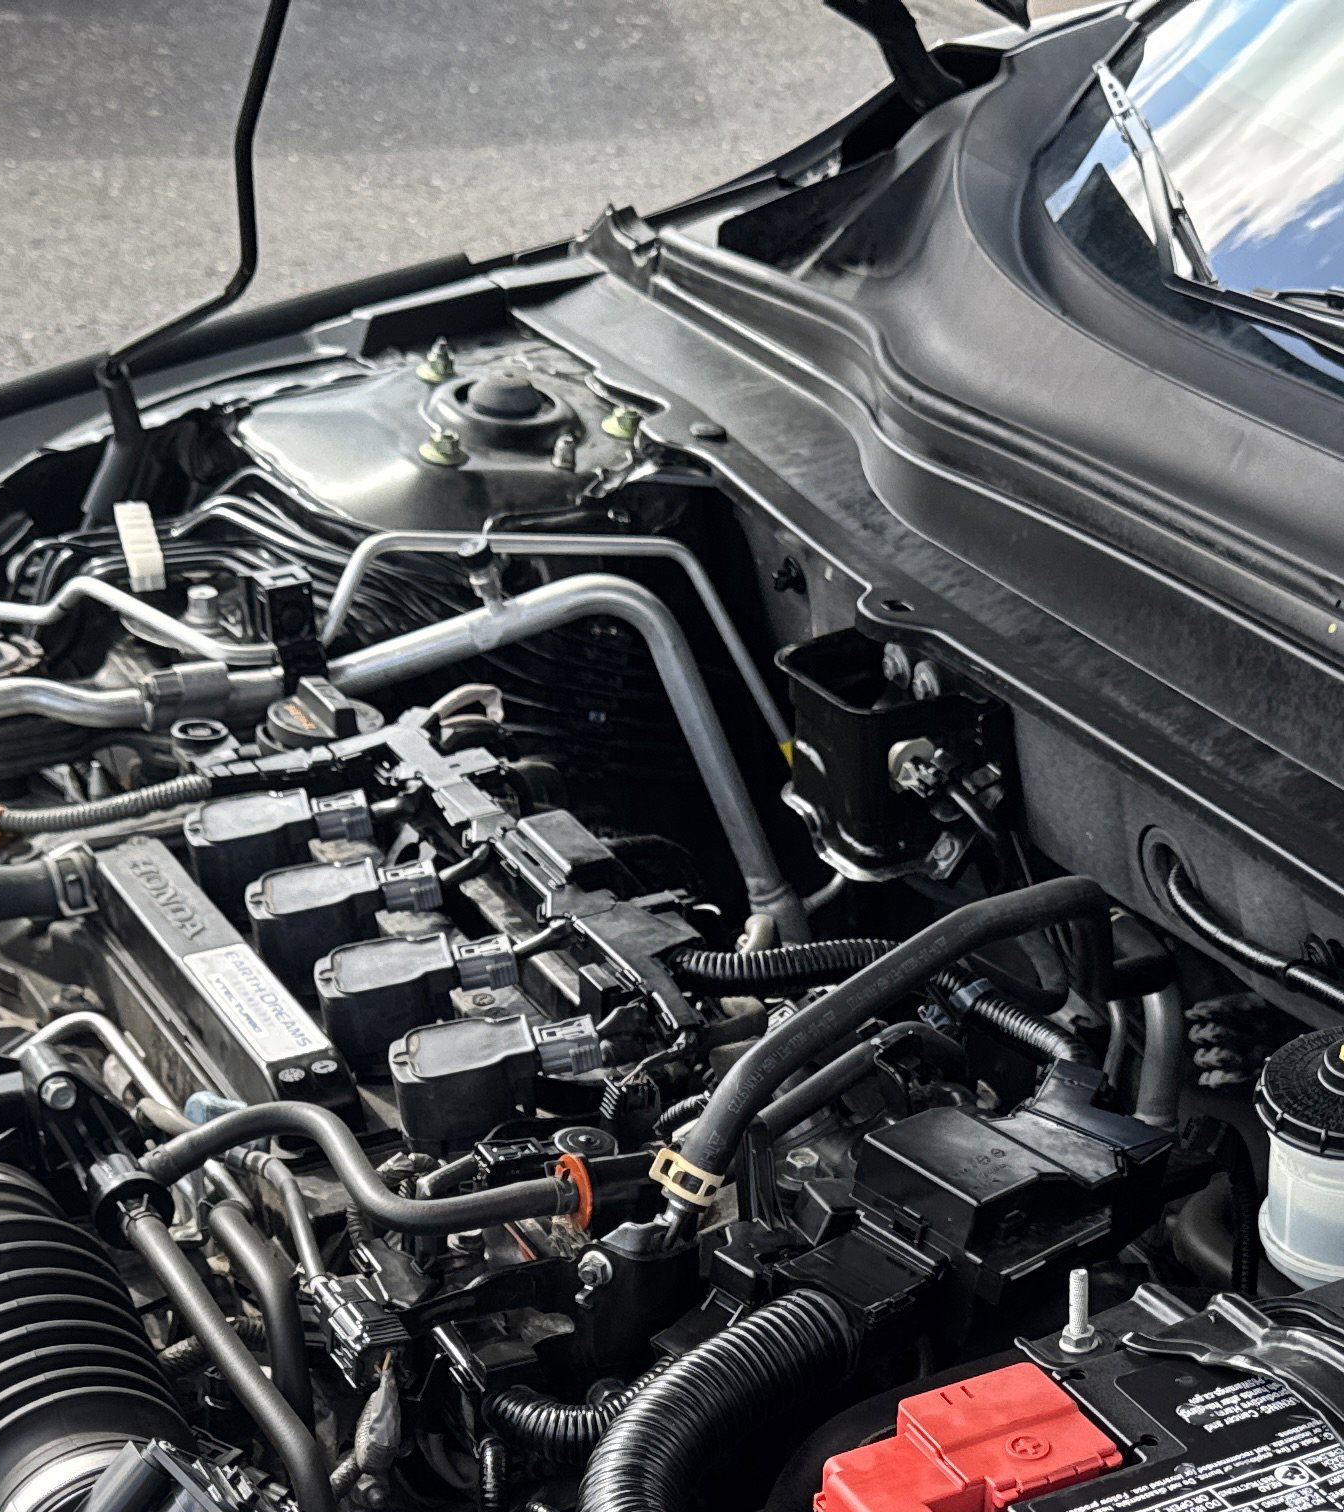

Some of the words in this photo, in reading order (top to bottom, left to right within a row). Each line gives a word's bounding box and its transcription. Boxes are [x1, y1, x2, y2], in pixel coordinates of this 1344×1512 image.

[129, 858, 207, 941] HONDA
[1238, 1385, 1270, 1400] hands
[1218, 1394, 1242, 1407] after
[1213, 1403, 1243, 1418] Harm
[1221, 1408, 1260, 1426] Cancer
[1201, 1420, 1226, 1433] and
[1288, 1442, 1301, 1451] of
[1298, 1435, 1321, 1447] Risk
[1252, 1444, 1272, 1454] Not
[1194, 1449, 1256, 1473] recommended
[1147, 1473, 1185, 1489] inverted
[1165, 1481, 1184, 1491] not
[1181, 1477, 1197, 1486] Do
[1256, 1479, 1282, 1493] READ
[1097, 1491, 1130, 1505] Follow
[1190, 1493, 1210, 1504] OR
[1203, 1498, 1223, 1509] DO
[1310, 1496, 1327, 1506] NO
